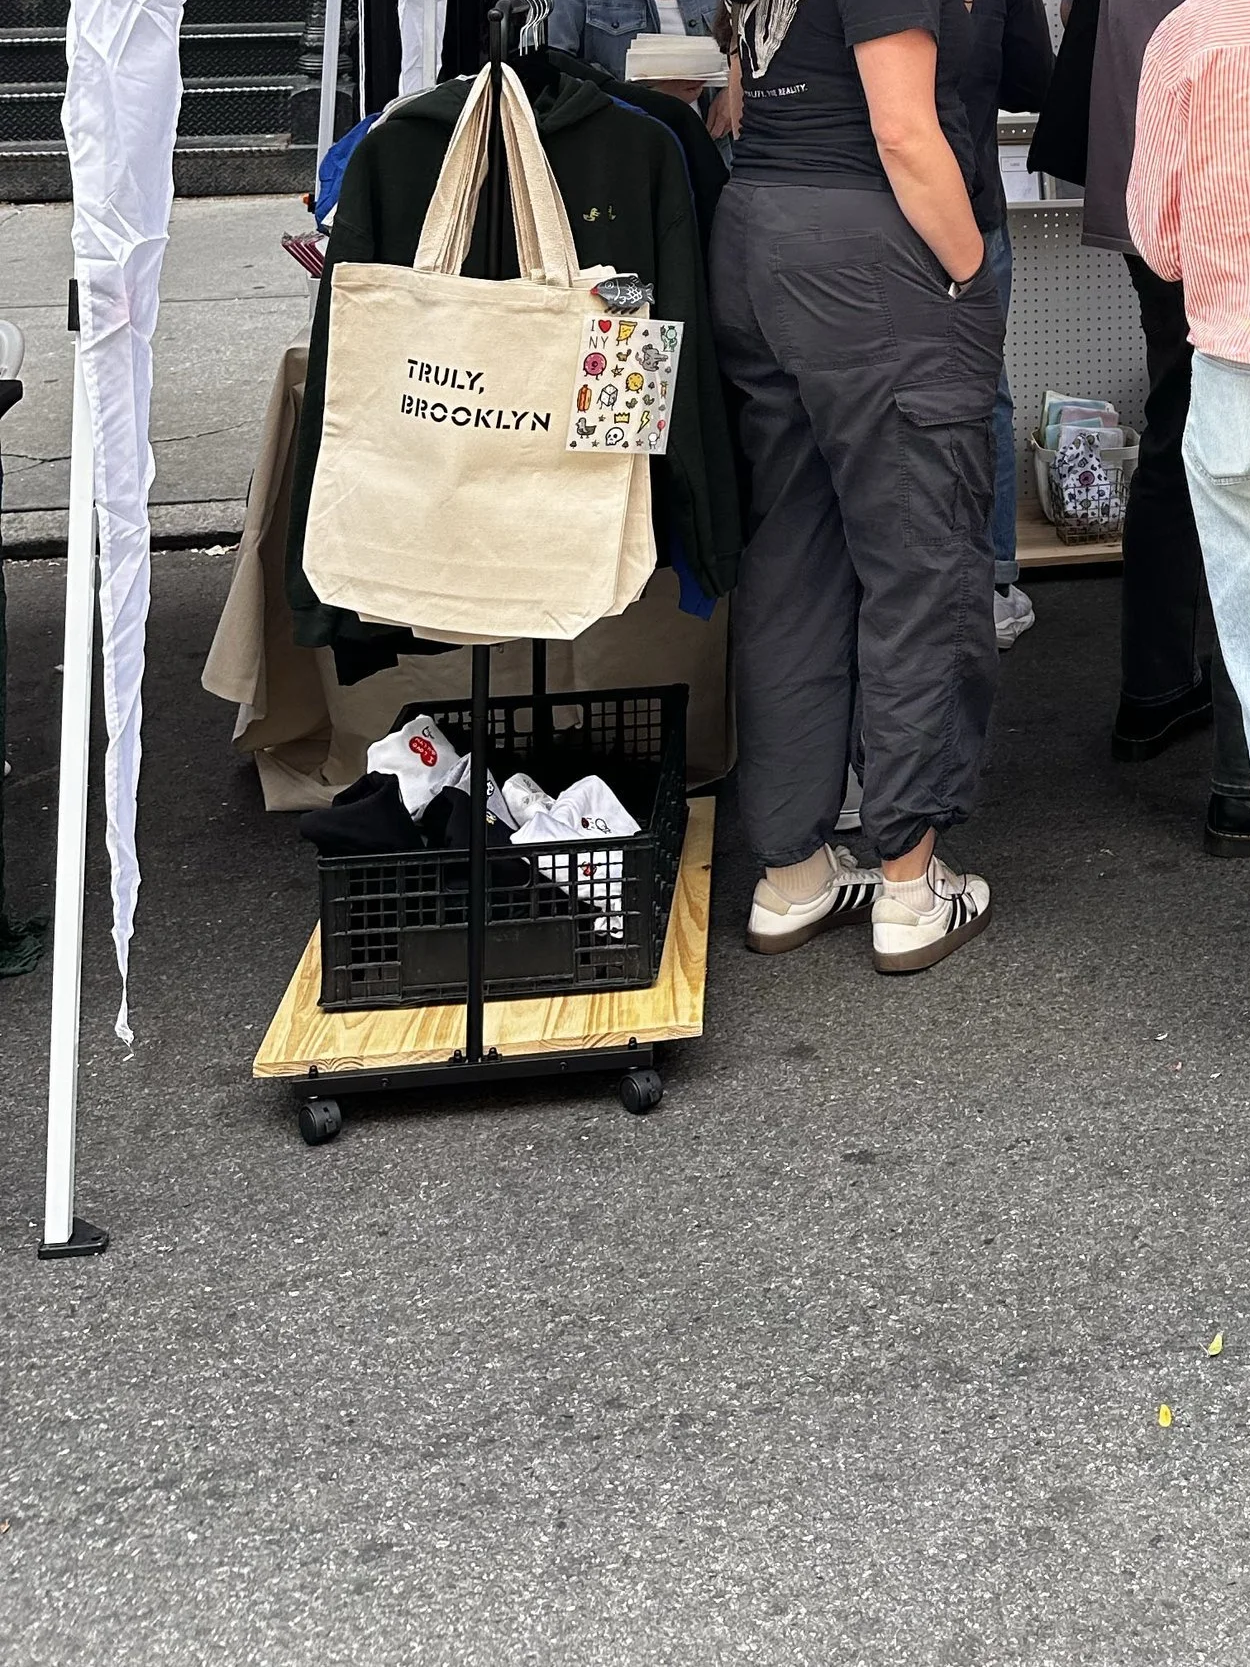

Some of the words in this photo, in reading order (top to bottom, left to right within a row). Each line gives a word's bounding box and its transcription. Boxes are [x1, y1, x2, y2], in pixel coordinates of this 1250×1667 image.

[588, 336, 609, 349] NY
[407, 359, 485, 394] TRULY,
[400, 394, 552, 432] BROOKLYN
